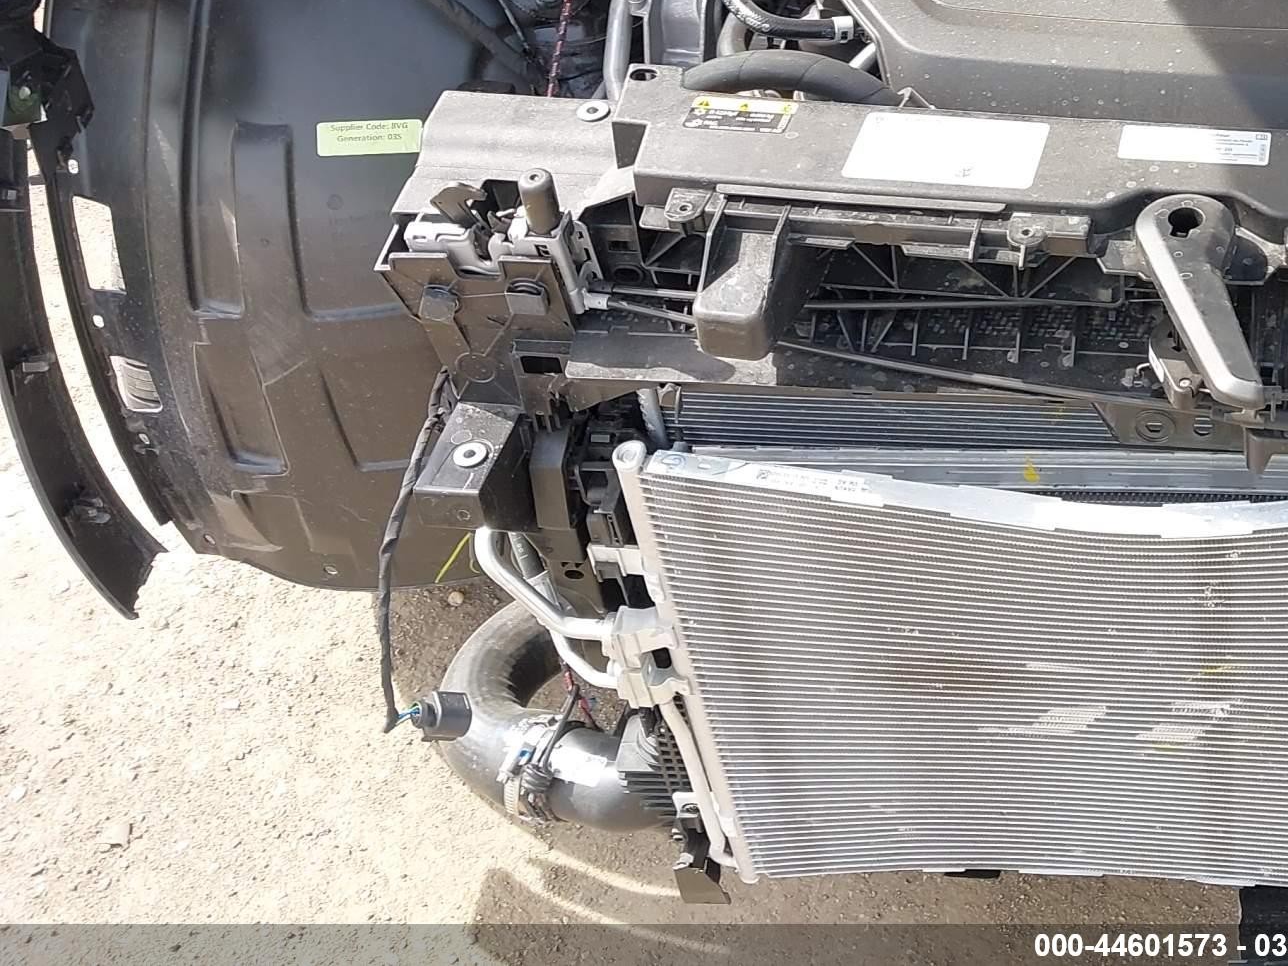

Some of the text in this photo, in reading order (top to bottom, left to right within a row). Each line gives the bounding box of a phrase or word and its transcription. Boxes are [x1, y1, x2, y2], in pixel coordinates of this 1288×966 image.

[330, 123, 364, 133] Supplier
[365, 121, 390, 131] Code:
[336, 134, 386, 143] Generation:
